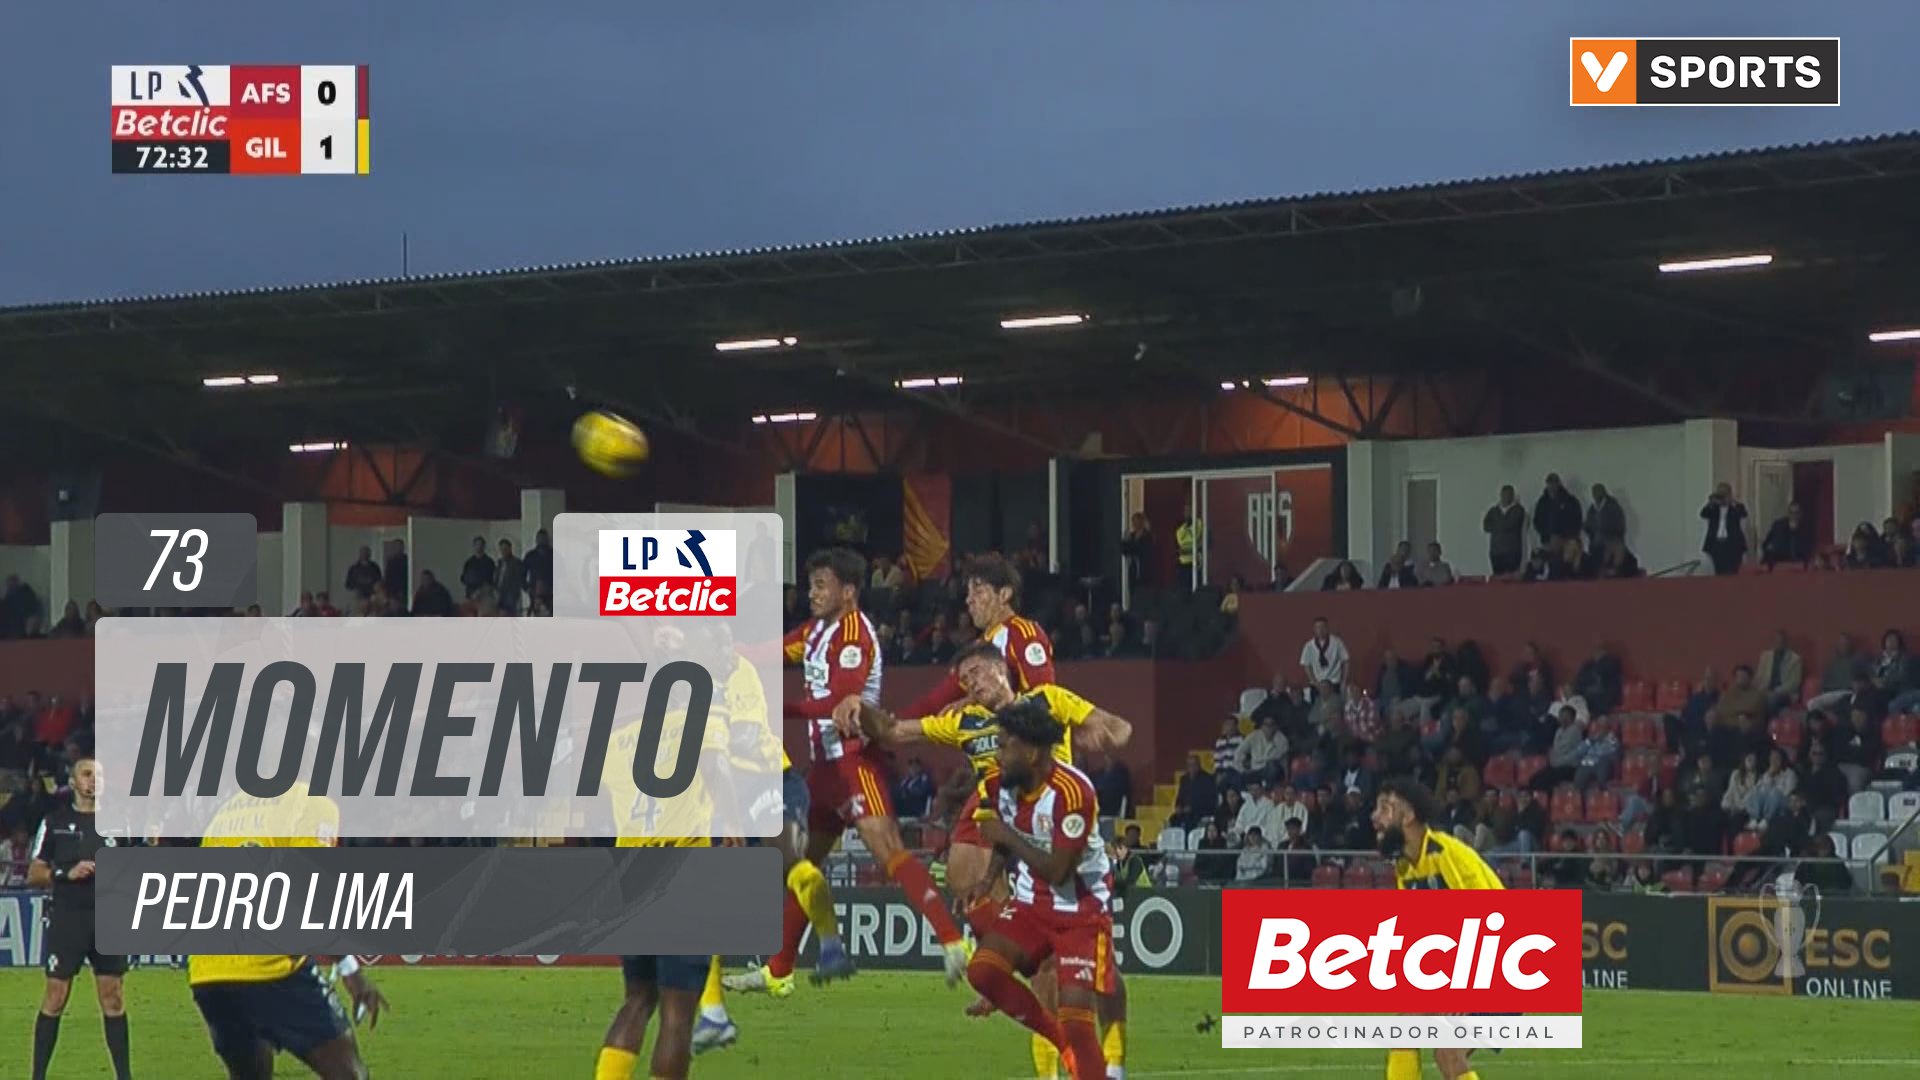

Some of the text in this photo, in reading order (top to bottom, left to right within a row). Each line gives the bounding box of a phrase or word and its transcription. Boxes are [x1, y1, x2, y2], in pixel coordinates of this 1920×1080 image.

[1582, 921, 1627, 960] SC
[1805, 929, 1890, 969] ESC
[1582, 968, 1628, 989] LINE
[1806, 977, 1892, 1000] ONLINE
